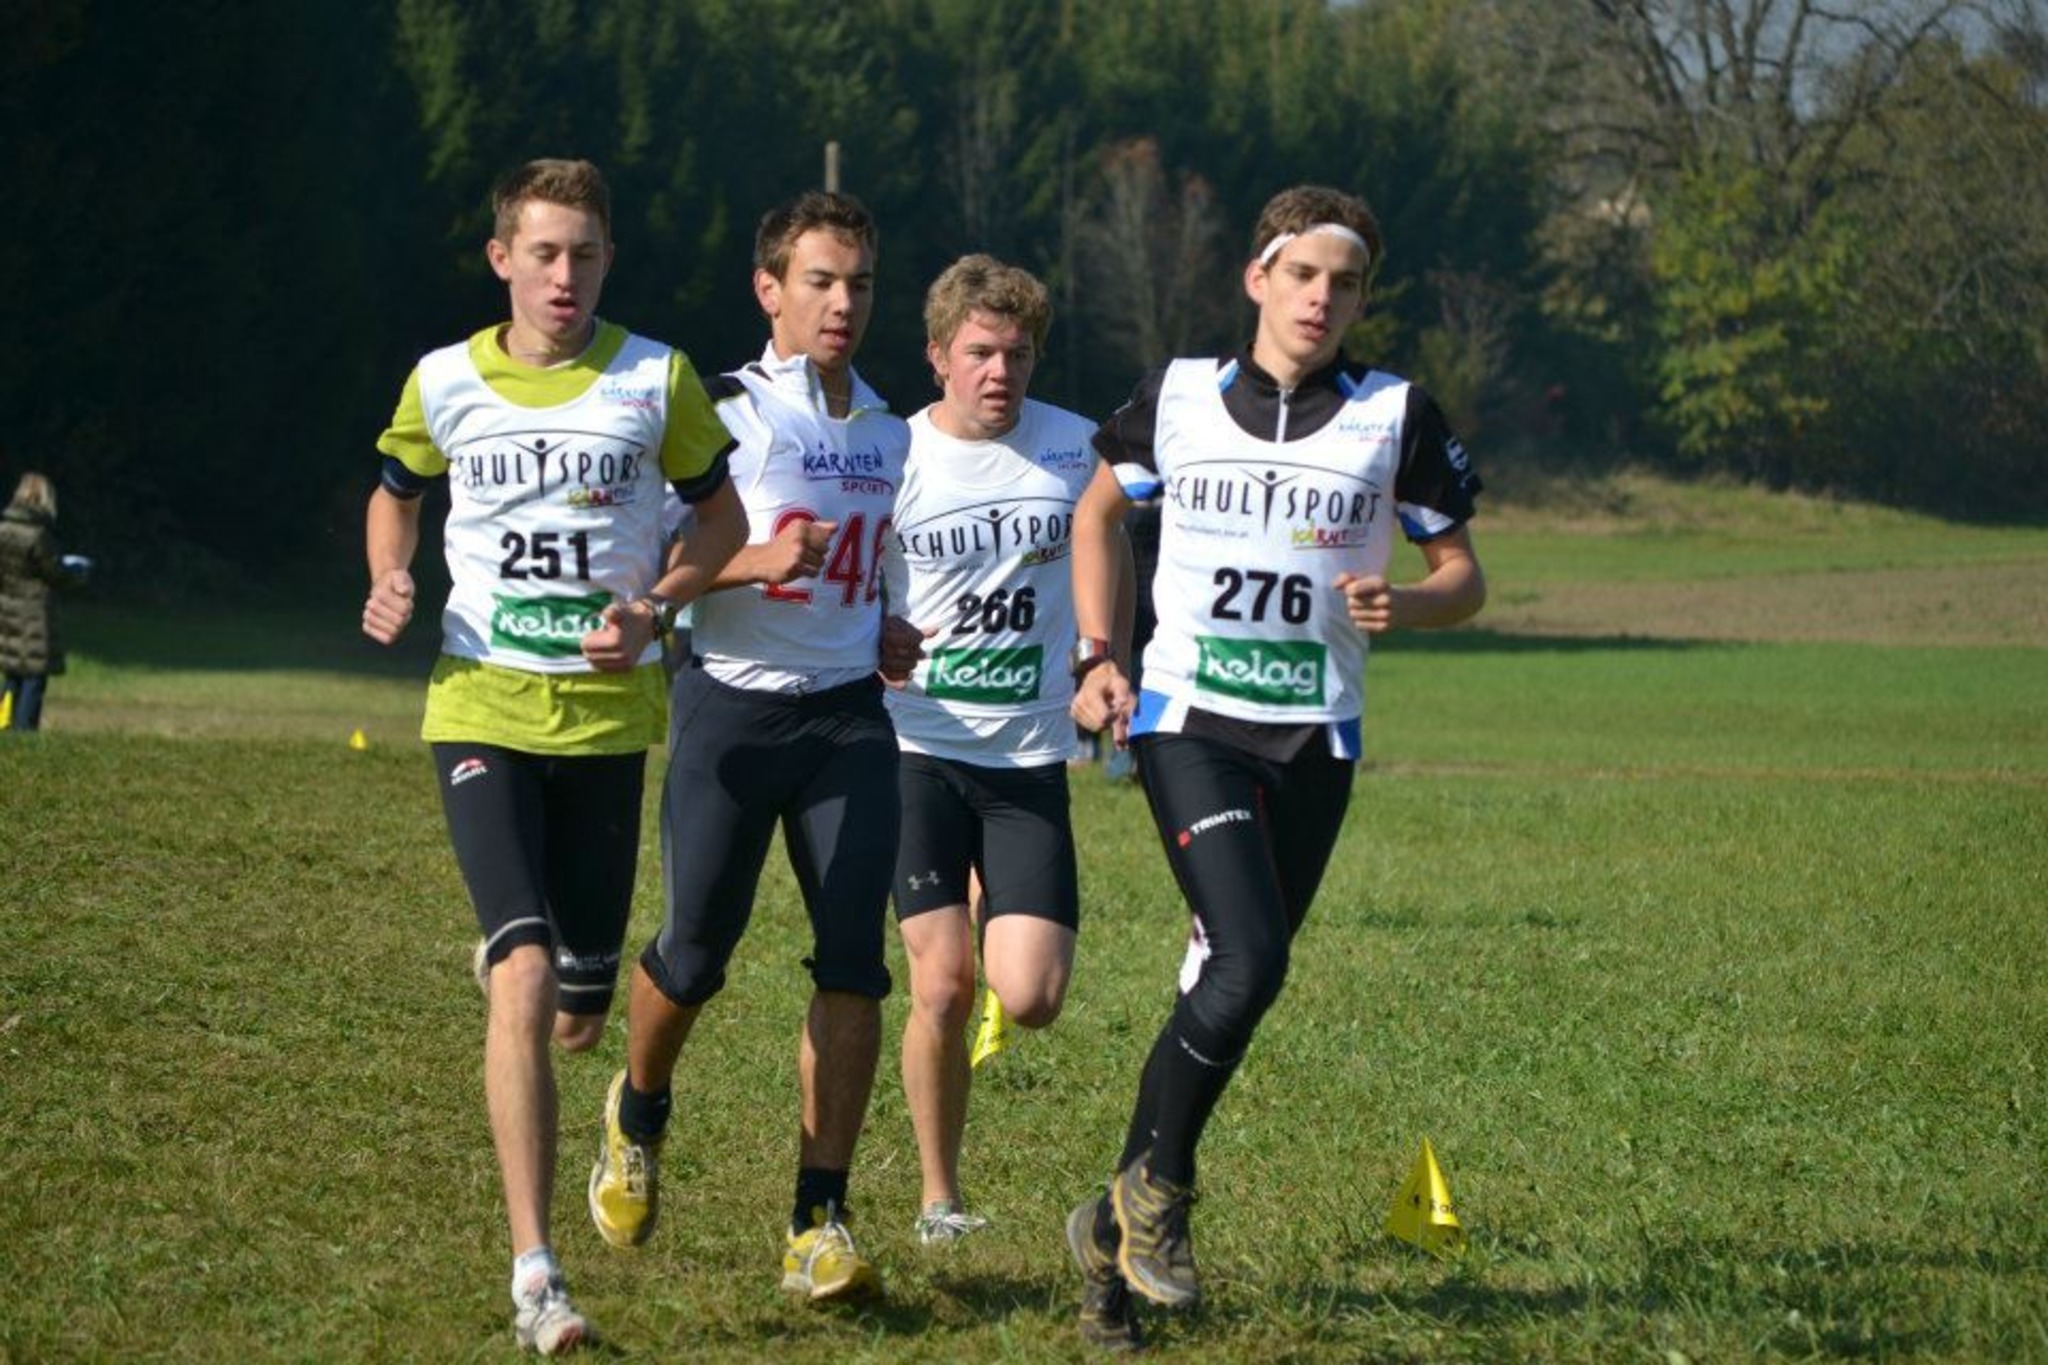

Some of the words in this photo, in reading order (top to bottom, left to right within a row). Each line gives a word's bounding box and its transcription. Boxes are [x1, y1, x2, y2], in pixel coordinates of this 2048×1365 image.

[1286, 487, 1381, 524] SPORT
[500, 531, 590, 580] 251
[951, 586, 1036, 635] 266
[1211, 567, 1313, 624] 276
[1203, 642, 1317, 695] kelag
